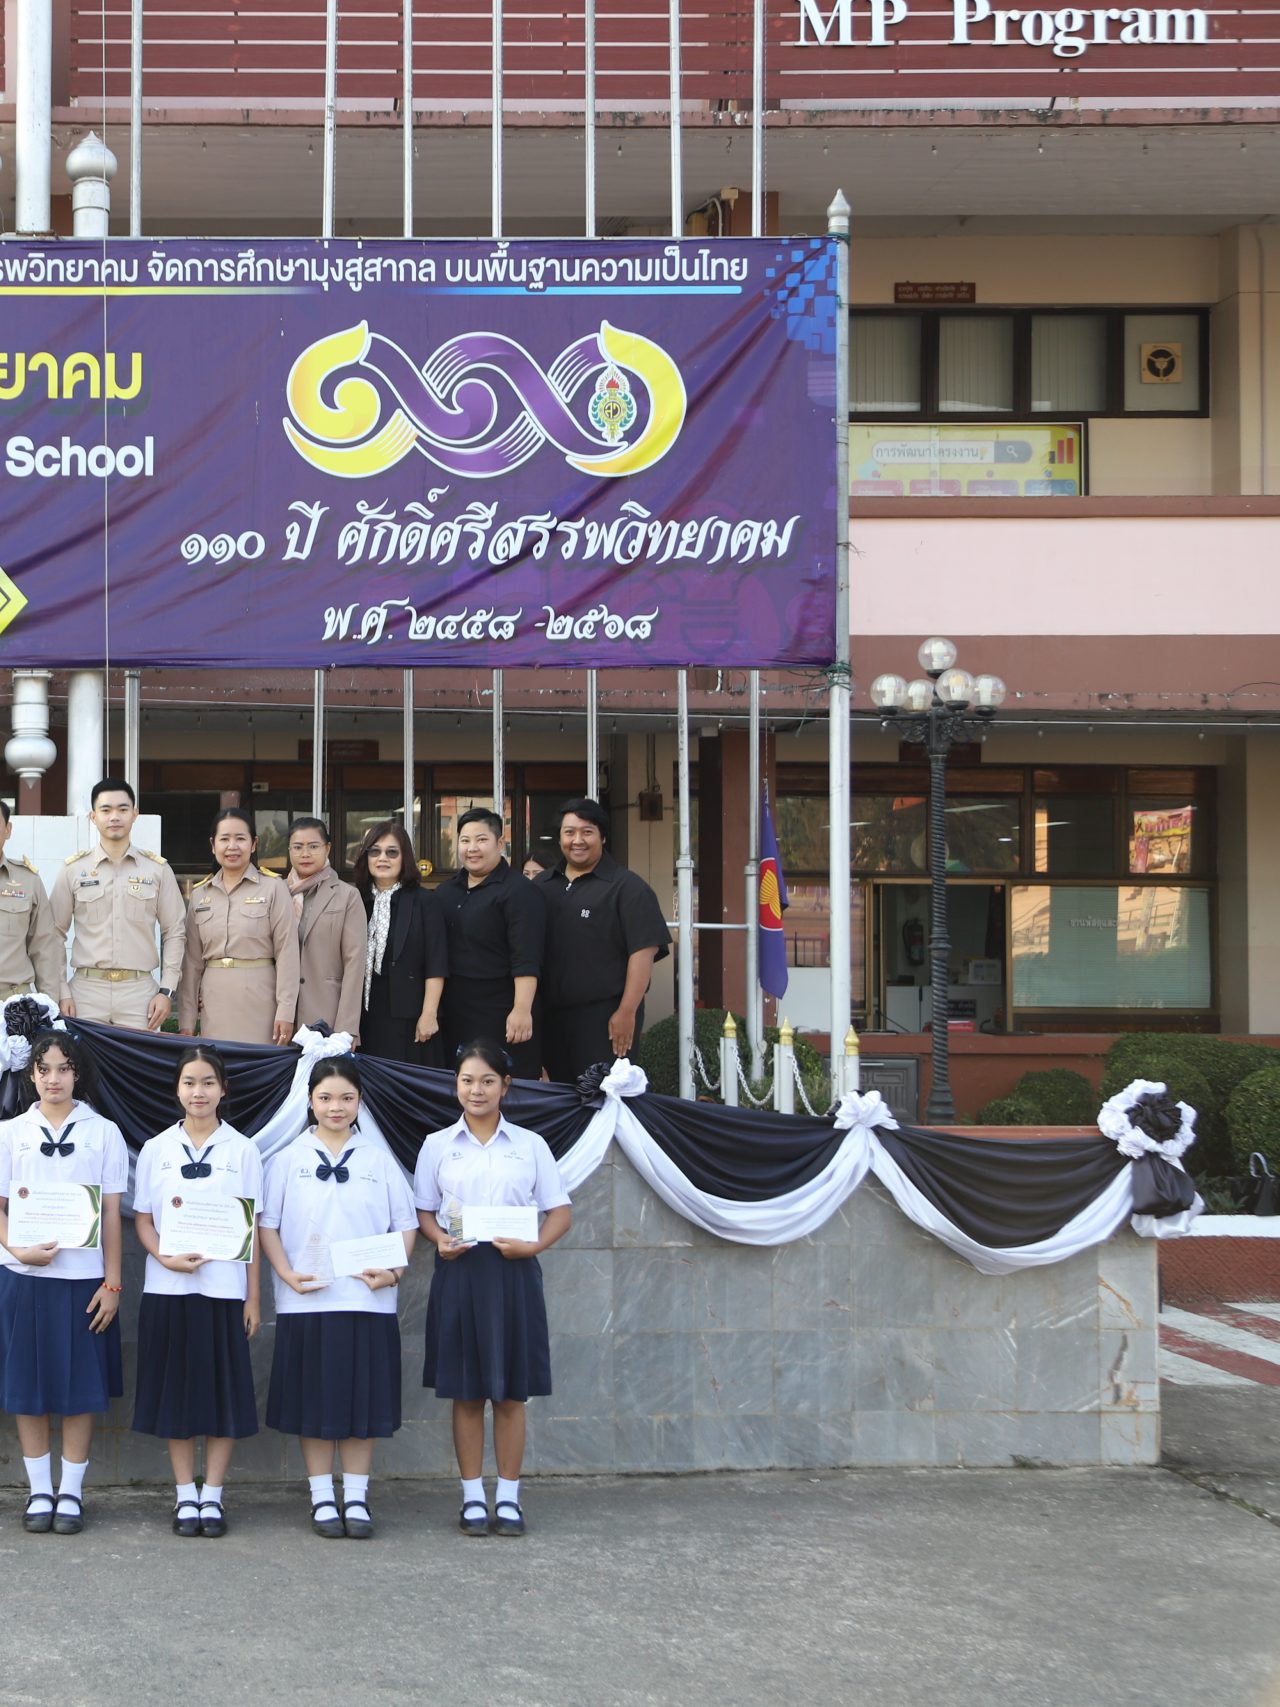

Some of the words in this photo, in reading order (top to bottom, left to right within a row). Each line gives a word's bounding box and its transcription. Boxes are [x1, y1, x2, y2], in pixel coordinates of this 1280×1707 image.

[793, 0, 908, 47] MP
[948, 0, 1209, 58] Program
[147, 242, 435, 291] จัดการศึกษามุ่งสู่สากล
[445, 242, 748, 288] บนพื้นฐานความเป็นไทย
[5, 436, 154, 477] School
[282, 501, 329, 561] ปี
[337, 485, 801, 566] ศักดิ์ศรีสรรพวิทยาคม
